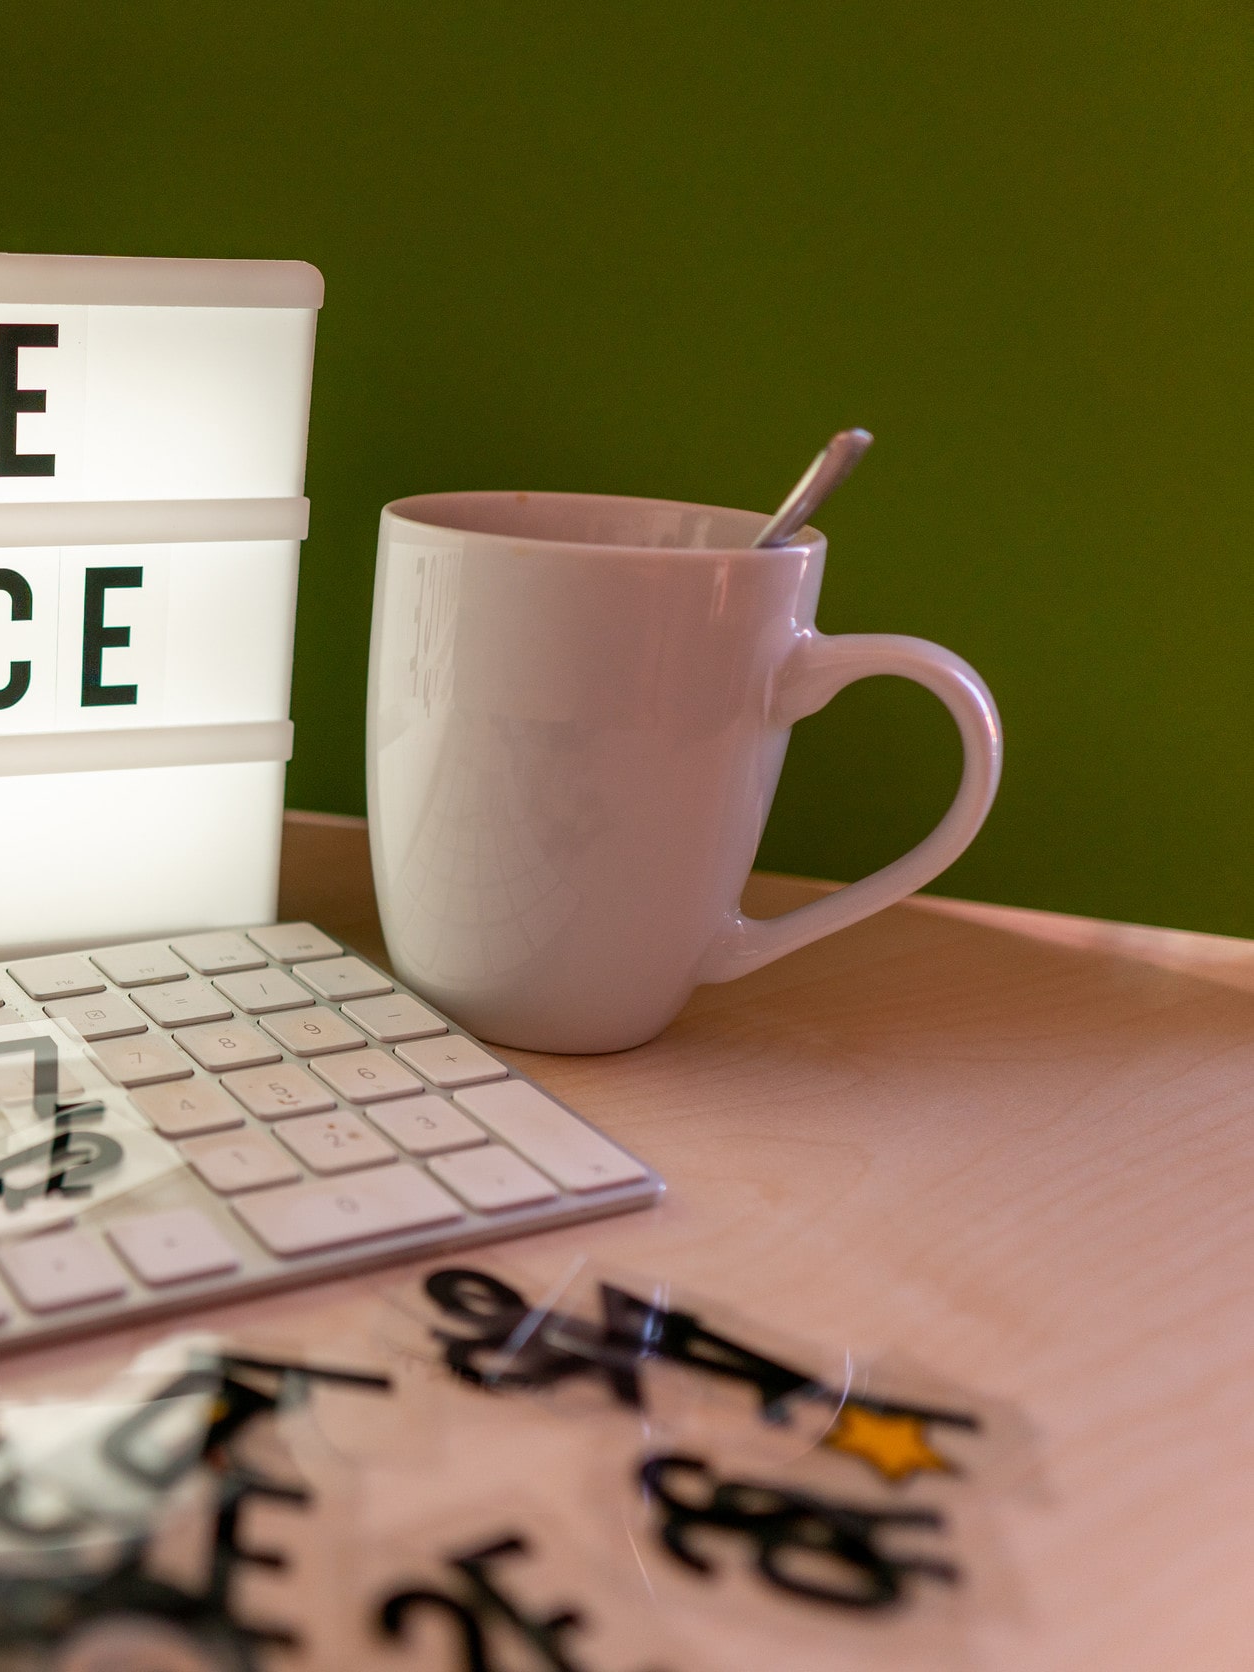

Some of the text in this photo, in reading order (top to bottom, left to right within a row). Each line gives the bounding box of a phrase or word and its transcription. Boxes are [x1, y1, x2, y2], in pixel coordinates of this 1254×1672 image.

[303, 1022, 322, 1036] 9
[217, 1037, 237, 1050] 8
[127, 1052, 143, 1065] 7
[356, 1067, 377, 1081] 6
[179, 1098, 197, 1112] 4
[414, 1114, 438, 1131] 3
[323, 1132, 346, 1149] 2
